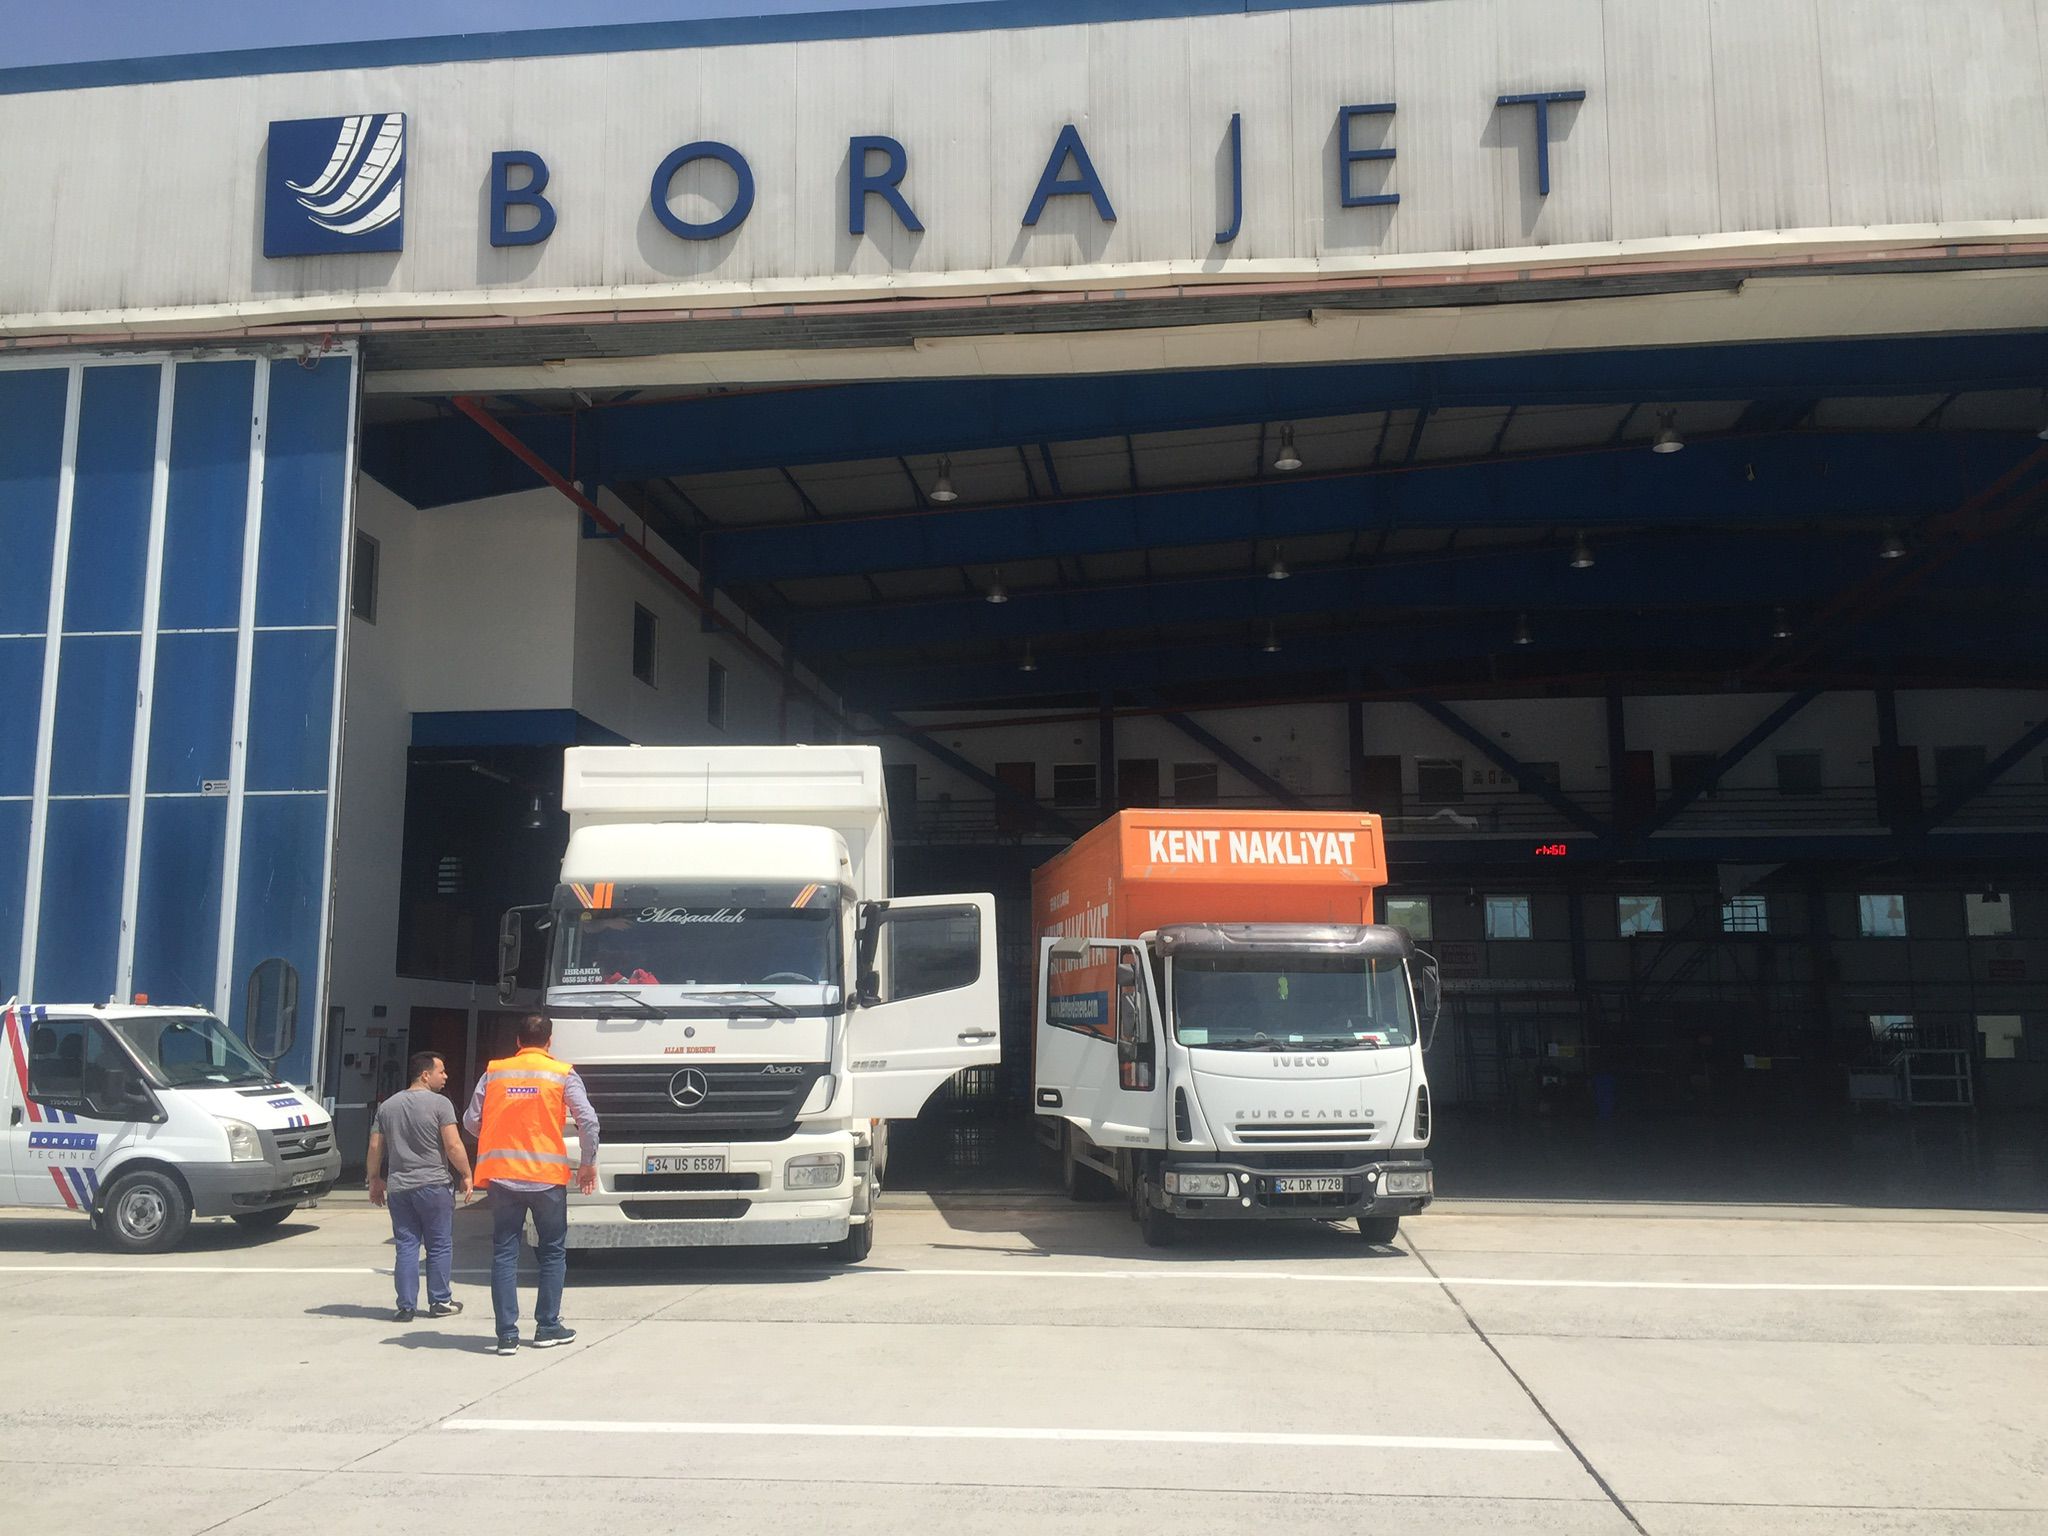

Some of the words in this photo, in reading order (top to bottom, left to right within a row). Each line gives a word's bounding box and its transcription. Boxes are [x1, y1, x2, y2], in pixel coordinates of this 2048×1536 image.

[489, 90, 1586, 248] BORAJET
[1149, 830, 1220, 863] KENT
[664, 1046, 685, 1054] ALLAH
[1273, 1056, 1330, 1067] IVECO
[1235, 1109, 1375, 1119] EUROCARGO
[31, 1137, 95, 1146] BORAJET
[28, 1150, 96, 1160] TECHNIC
[655, 1159, 668, 1171] 34
[674, 1158, 689, 1171] US
[693, 1158, 722, 1171] 6587
[1280, 1180, 1295, 1192] 34
[1299, 1179, 1313, 1191] DR
[1316, 1178, 1341, 1191] 1728
